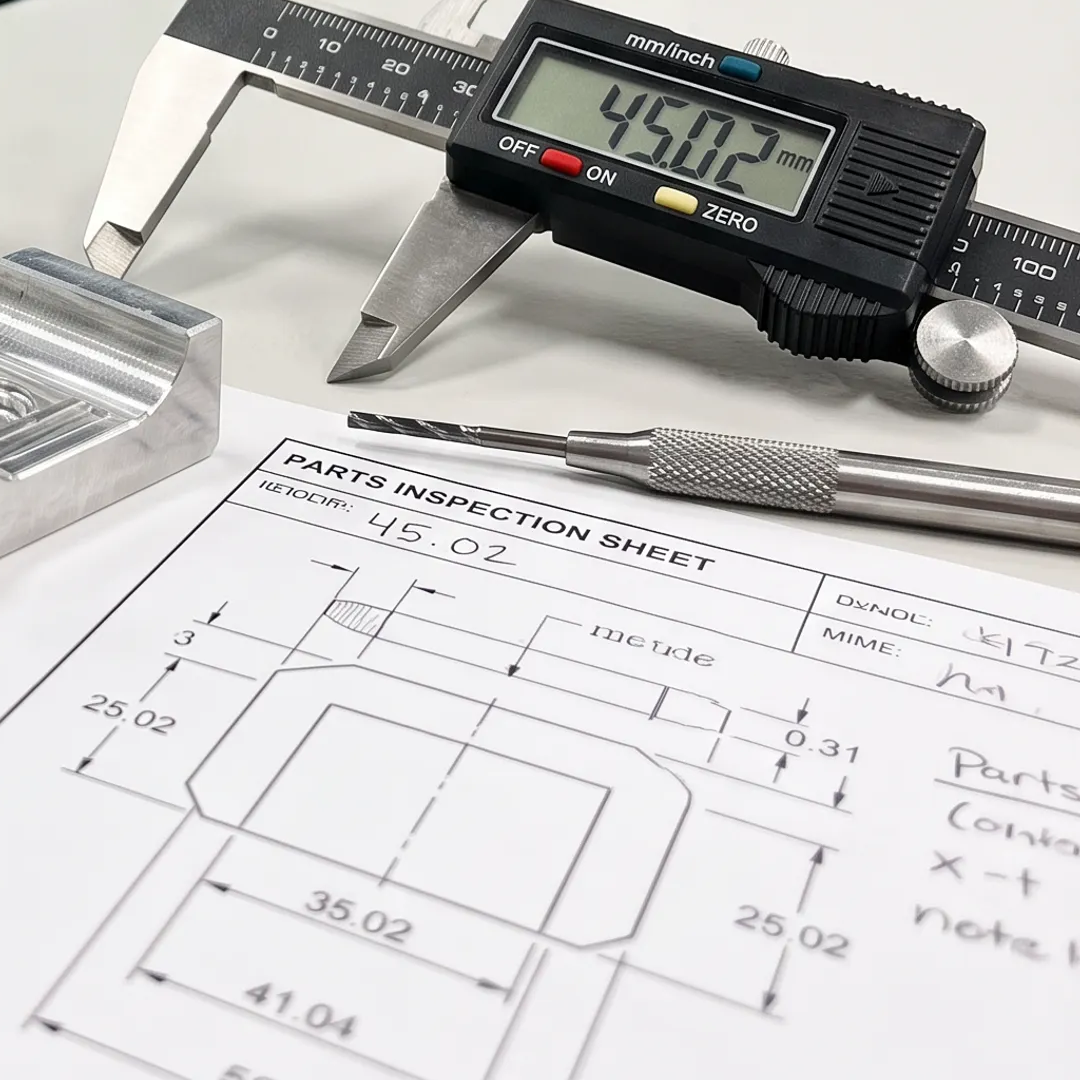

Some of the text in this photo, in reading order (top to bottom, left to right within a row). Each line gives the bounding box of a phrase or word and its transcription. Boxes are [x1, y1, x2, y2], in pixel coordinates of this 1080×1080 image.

[263, 26, 279, 40] 0
[319, 37, 342, 54] 10
[381, 58, 411, 76] 20
[624, 32, 716, 69] mm/inch
[498, 135, 619, 188] OFF ON
[599, 83, 815, 194] 45.02 mm
[700, 202, 759, 235] ZERO
[1012, 256, 1058, 282] 100
[282, 452, 716, 573] PARTS INSPECTION SHEET
[367, 511, 518, 566] 45.02
[173, 629, 196, 646] 3
[822, 627, 902, 658] MIME:
[81, 693, 178, 736] 25.02
[784, 728, 860, 765] 0.31
[948, 745, 1080, 802] Parts
[304, 889, 414, 945] 35.02
[733, 903, 851, 961] 25.02
[244, 981, 358, 1041] 41.04
